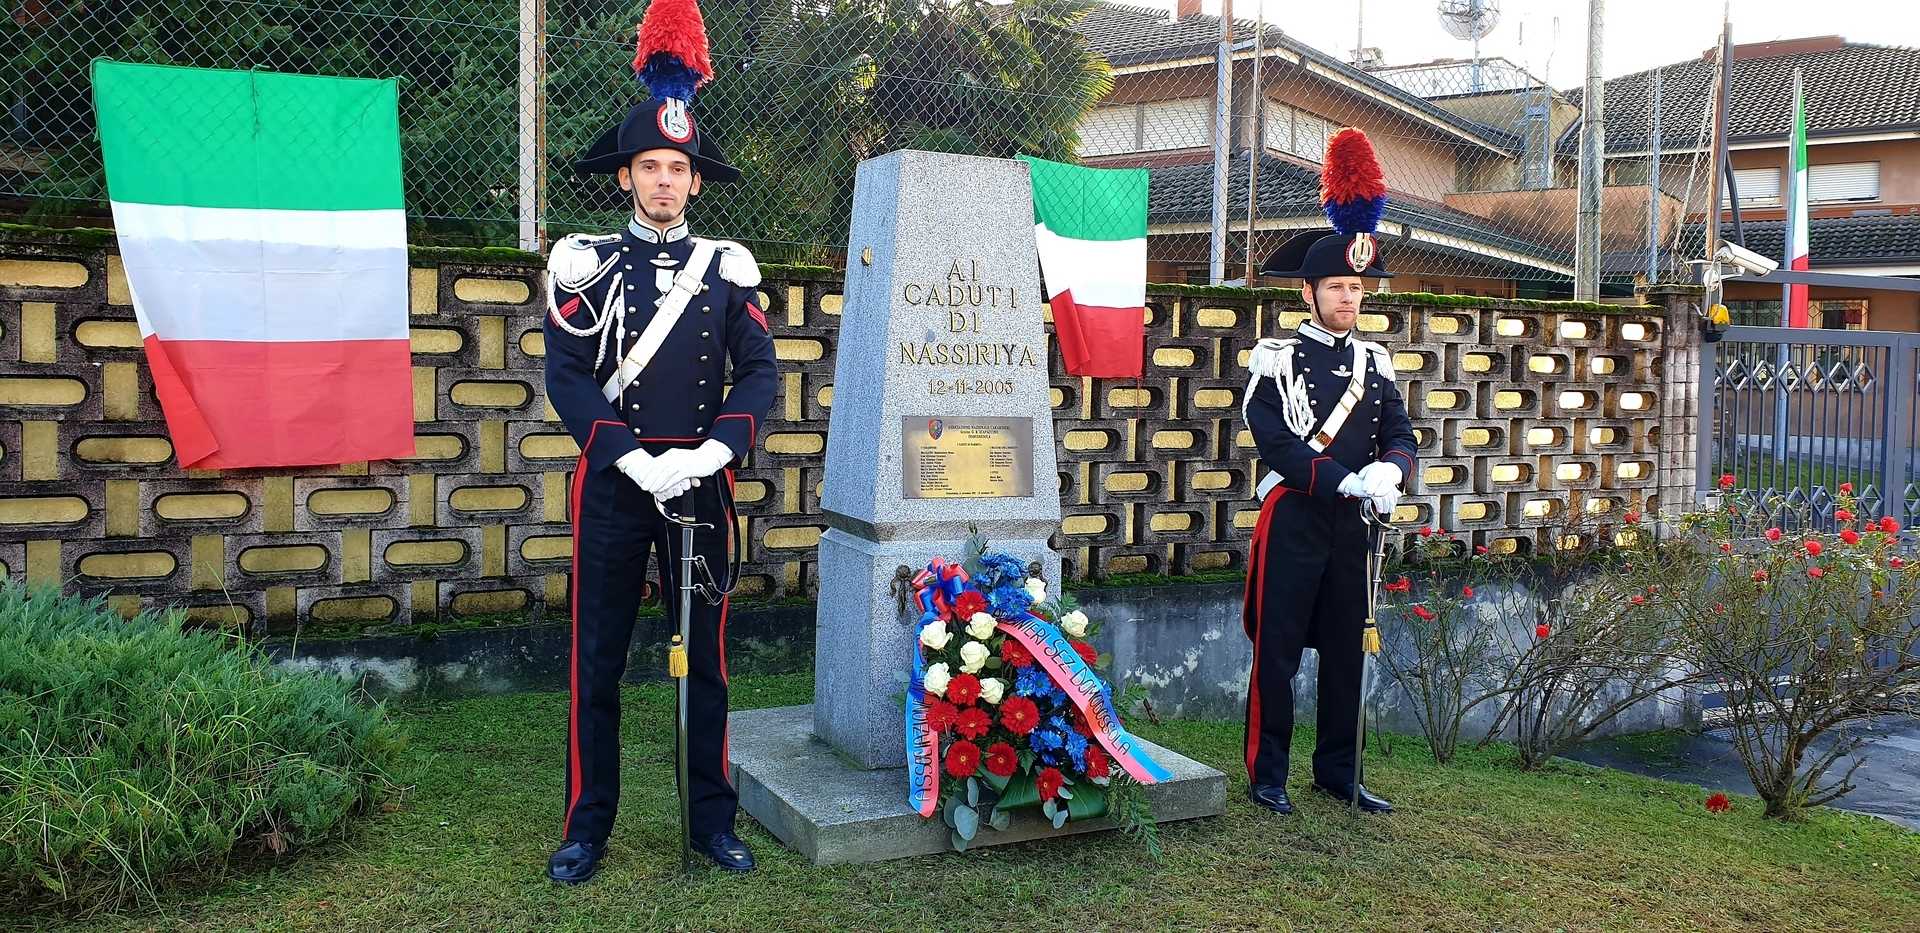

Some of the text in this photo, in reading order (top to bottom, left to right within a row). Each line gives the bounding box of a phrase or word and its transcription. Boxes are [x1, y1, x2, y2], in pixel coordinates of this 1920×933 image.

[947, 259, 978, 282] AI
[905, 283, 1017, 308] CADUTI
[949, 311, 980, 333] DI
[900, 342, 1037, 366] NASSIRIYA
[1044, 638, 1076, 675] SEZ
